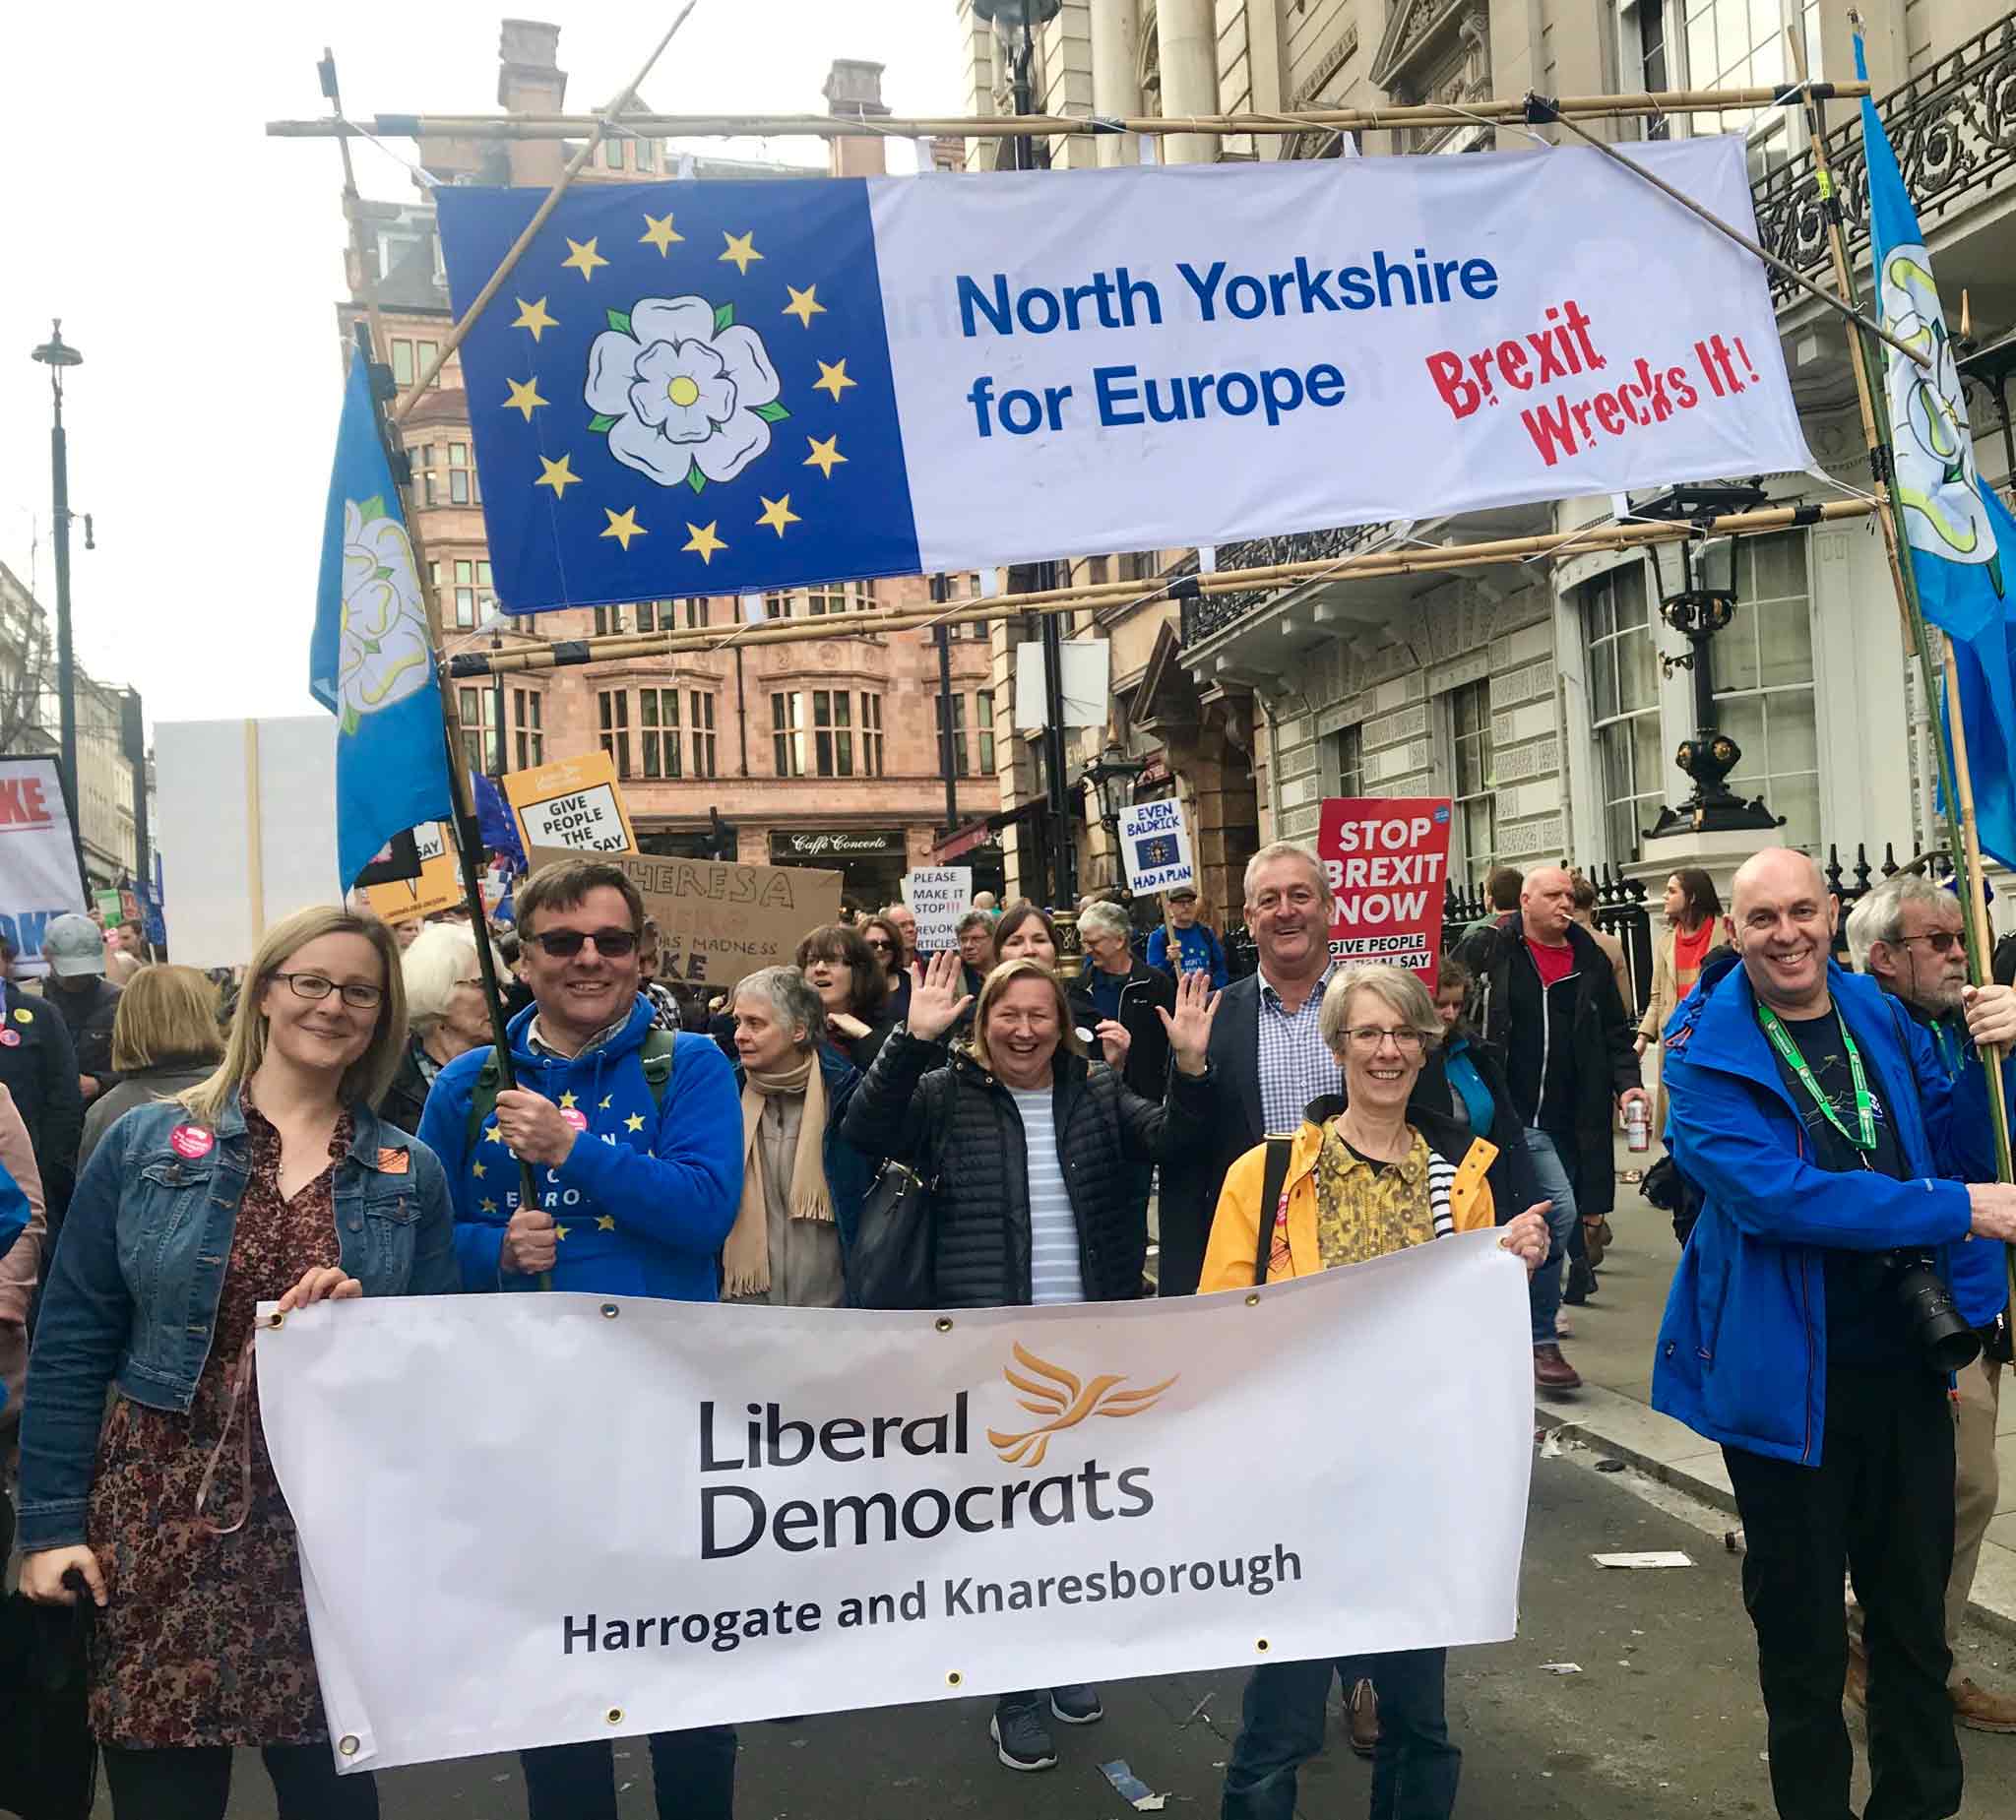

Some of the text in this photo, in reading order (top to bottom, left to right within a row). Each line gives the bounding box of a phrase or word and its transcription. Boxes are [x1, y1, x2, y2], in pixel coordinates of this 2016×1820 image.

[956, 248, 1499, 337] North Yorkshire
[1425, 300, 1607, 419] Brexit
[967, 362, 1346, 437] for Europe
[1521, 335, 1760, 467] Wrecks It!
[549, 795, 588, 815] GIVE
[1137, 802, 1172, 821] EVEN
[542, 808, 602, 835] PEOPLE
[1127, 816, 1181, 837] BALDRICK
[561, 826, 593, 845] THE
[593, 835, 622, 850] SAY
[829, 834, 887, 849] Concerto
[1339, 817, 1431, 851] STOP
[415, 840, 439, 859] SAY
[914, 872, 957, 883] PLEASE
[1133, 866, 1191, 890] HAD A PLAN
[1323, 853, 1444, 889] BREXIT
[606, 858, 794, 910] HERESA
[914, 889, 965, 900] MAKE IT
[914, 901, 961, 913] STOP!!!
[1334, 891, 1428, 925] NOW
[916, 923, 955, 935] REVOK
[693, 937, 778, 955] MADNESS
[1329, 935, 1423, 954] GIVE PEOPLE
[1400, 954, 1429, 969] SAY
[700, 1390, 969, 1473] Liberal
[700, 1459, 1155, 1559] Democrats
[563, 1543, 1302, 1655] Harrogate and Knaresborough
